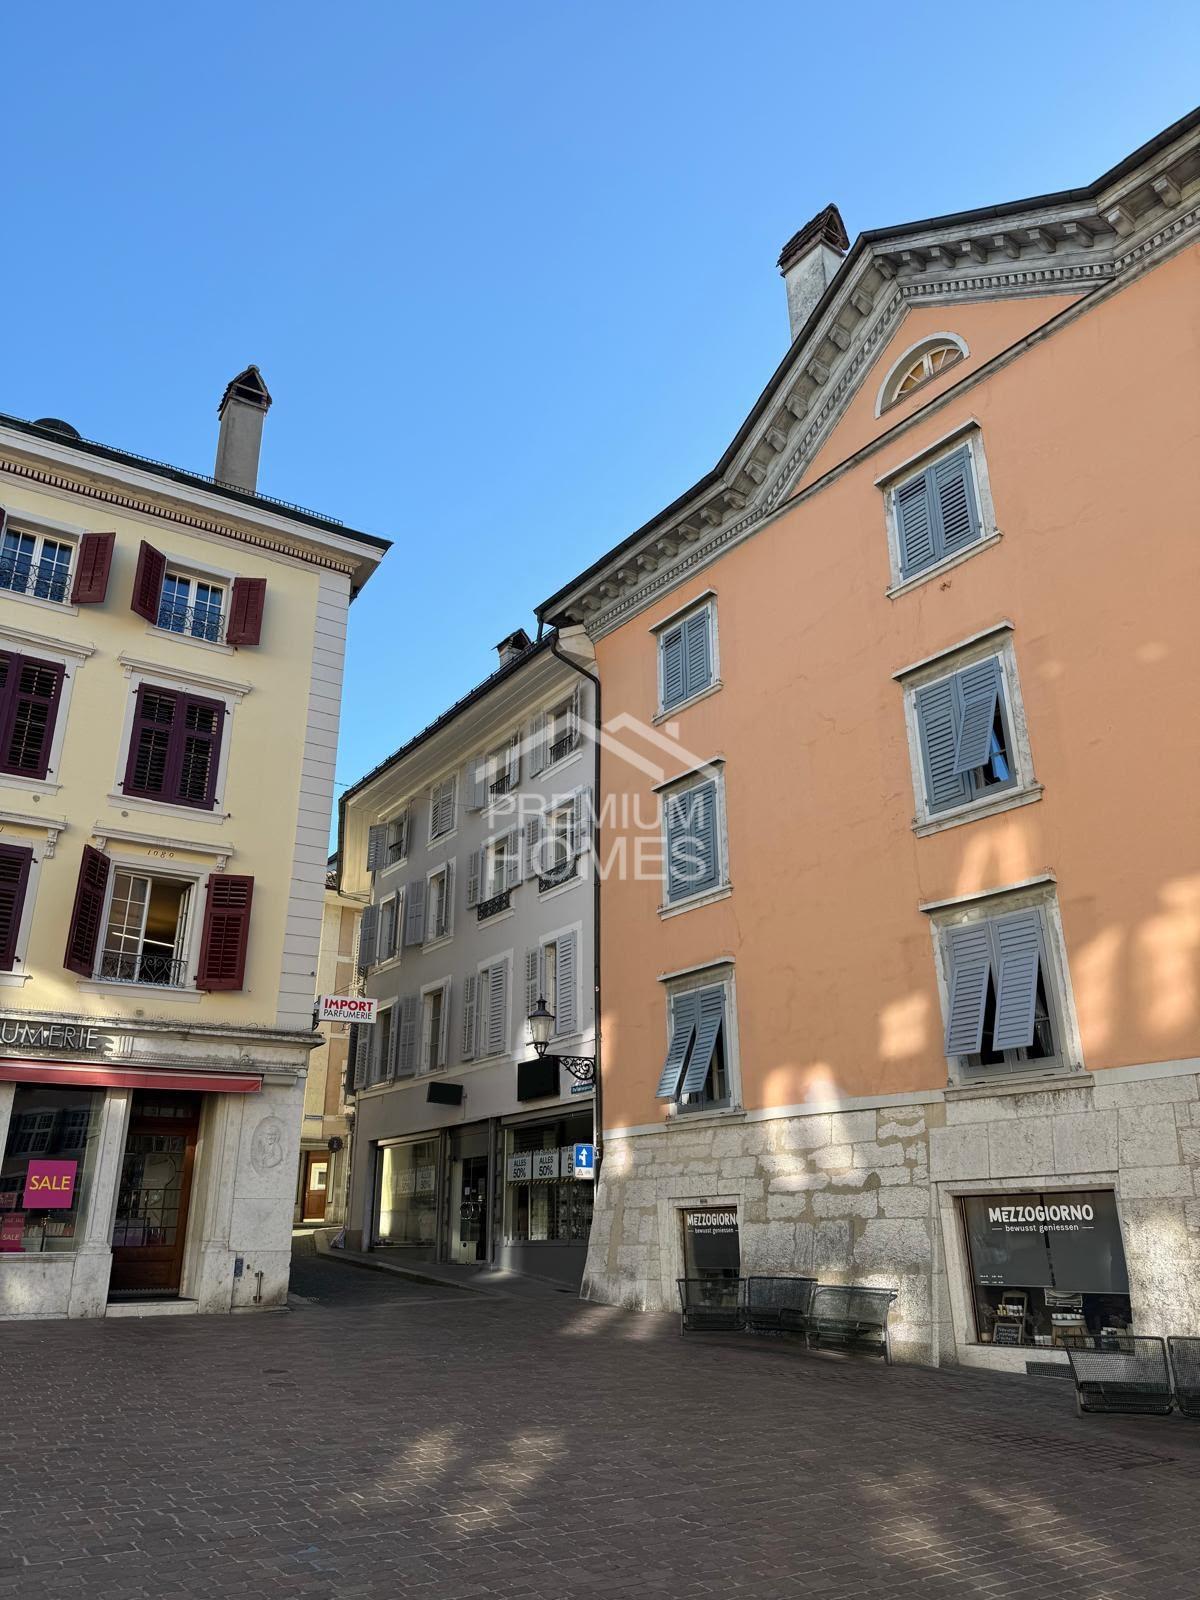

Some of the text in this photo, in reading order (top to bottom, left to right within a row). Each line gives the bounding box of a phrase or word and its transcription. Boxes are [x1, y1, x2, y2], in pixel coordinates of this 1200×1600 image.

[324, 998, 373, 1011] IMPORT
[323, 1009, 372, 1019] PARFUMERIE
[513, 1159, 527, 1167] ALLES
[540, 1156, 554, 1164] ALLES
[513, 1168, 526, 1178] 50%
[539, 1165, 553, 1176] 50%
[29, 1175, 71, 1190] SALE
[988, 1204, 1094, 1222] MEZZOGIORNO
[688, 1213, 737, 1226] MEZZOGIORN
[1005, 1223, 1079, 1233] bewusst geniessen
